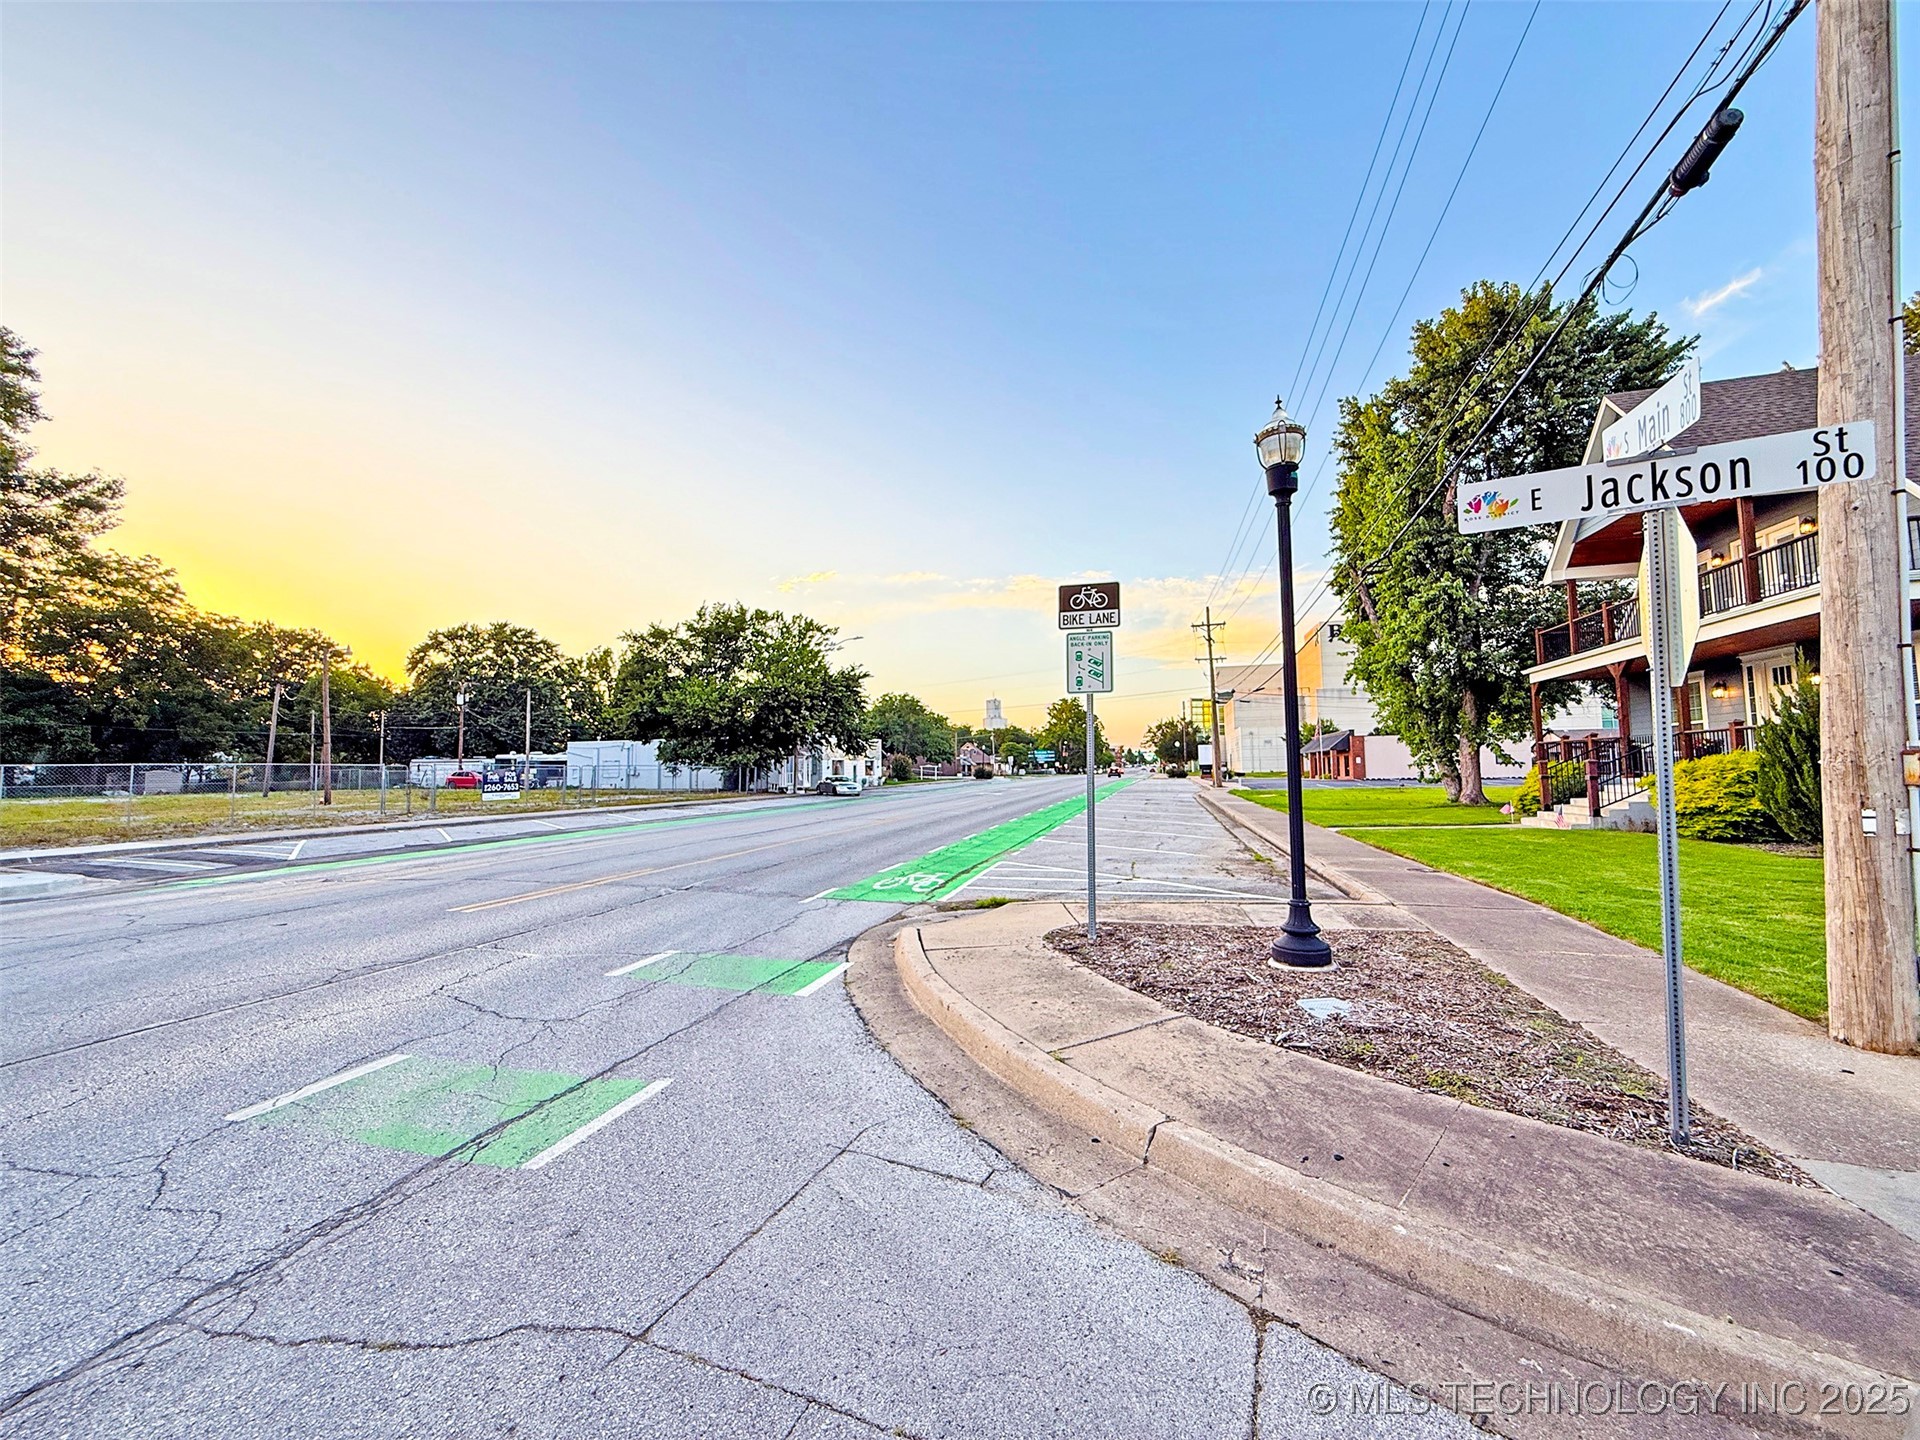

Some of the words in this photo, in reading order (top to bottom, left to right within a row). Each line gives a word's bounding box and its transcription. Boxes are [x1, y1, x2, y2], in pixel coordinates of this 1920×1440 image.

[1683, 369, 1692, 399] St
[1624, 432, 1630, 454] S
[1638, 401, 1670, 450] Main
[1680, 393, 1697, 429] 800
[1813, 427, 1849, 456] St
[1531, 488, 1542, 511] E
[1581, 456, 1751, 511] Jackson
[1796, 452, 1864, 485] 100
[1062, 614, 1085, 626] BIKE
[1089, 611, 1116, 625] LANE
